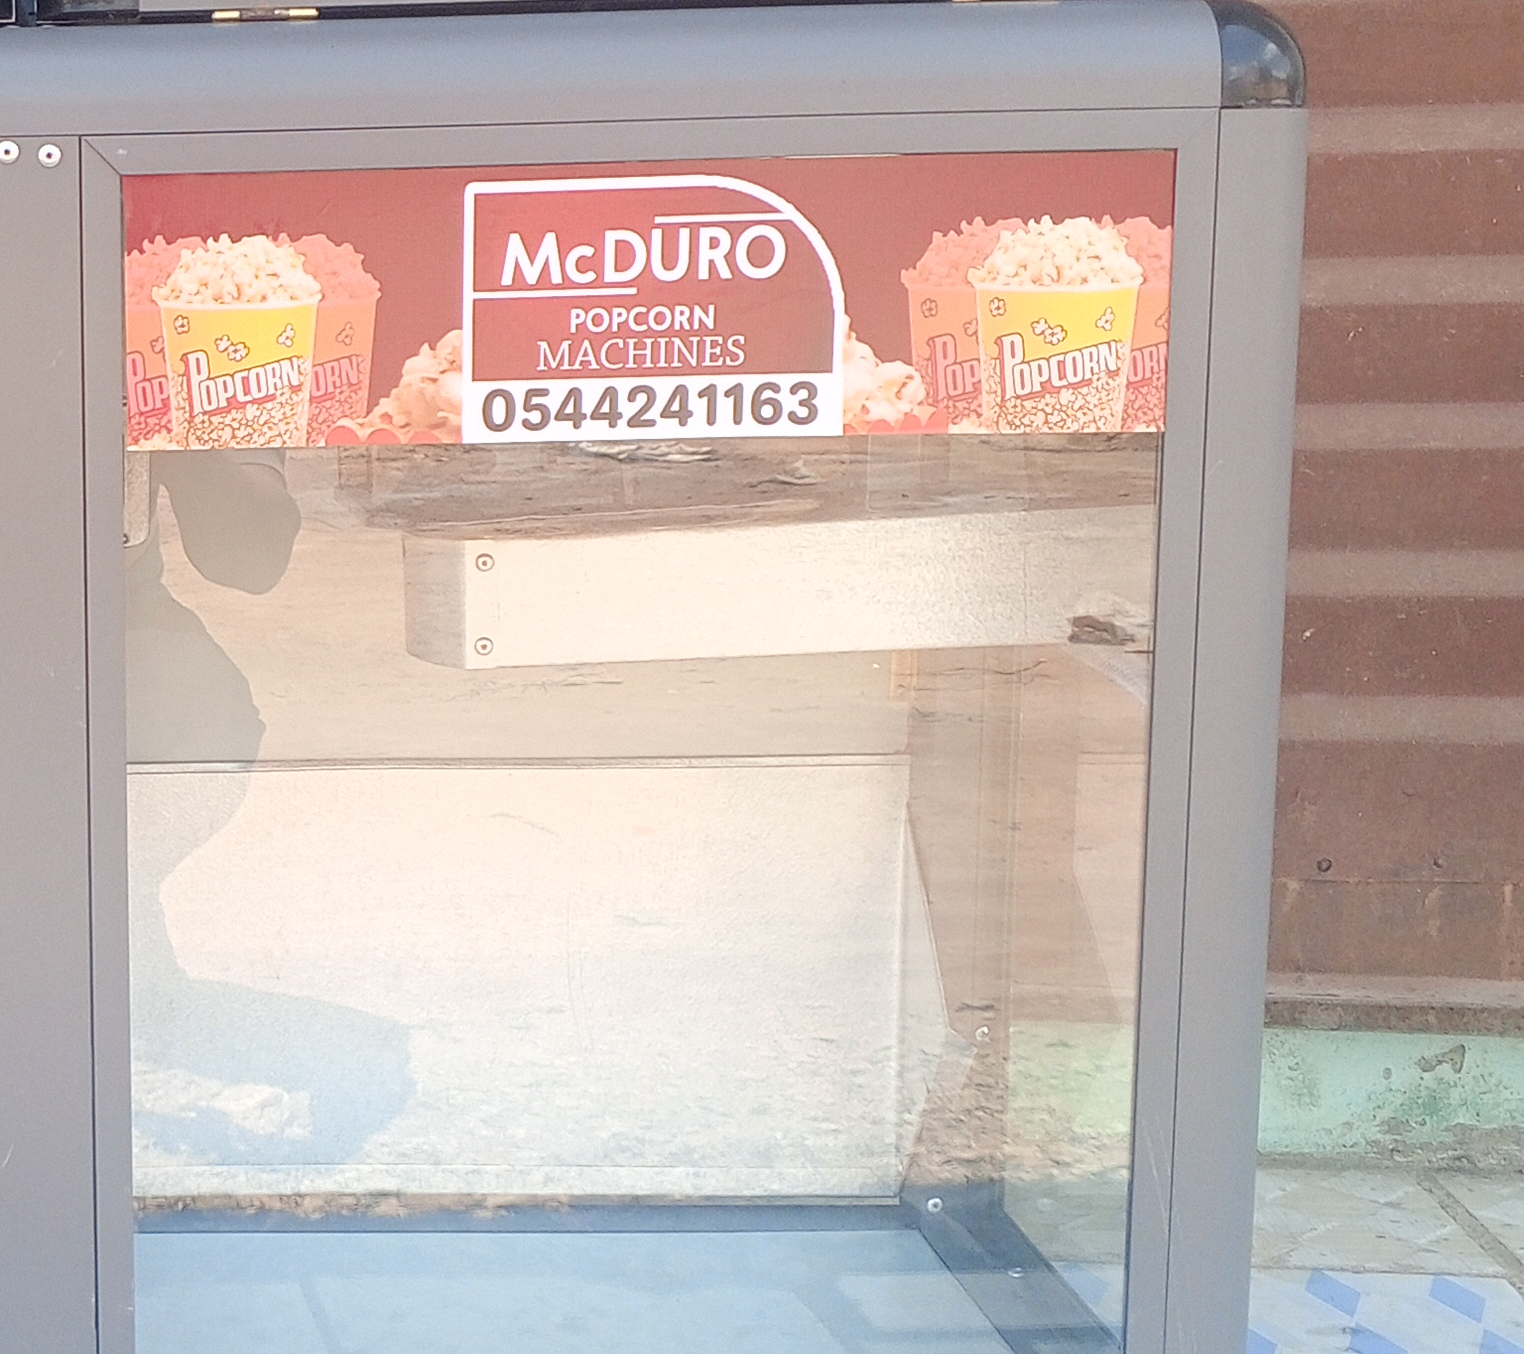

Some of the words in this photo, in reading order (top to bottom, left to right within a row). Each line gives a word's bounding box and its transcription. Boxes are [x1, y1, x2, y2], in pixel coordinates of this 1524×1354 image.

[500, 224, 787, 286] McDURO
[570, 304, 716, 334] POPCORN
[536, 335, 746, 371] MACHINES
[482, 381, 819, 432] 0544241163
